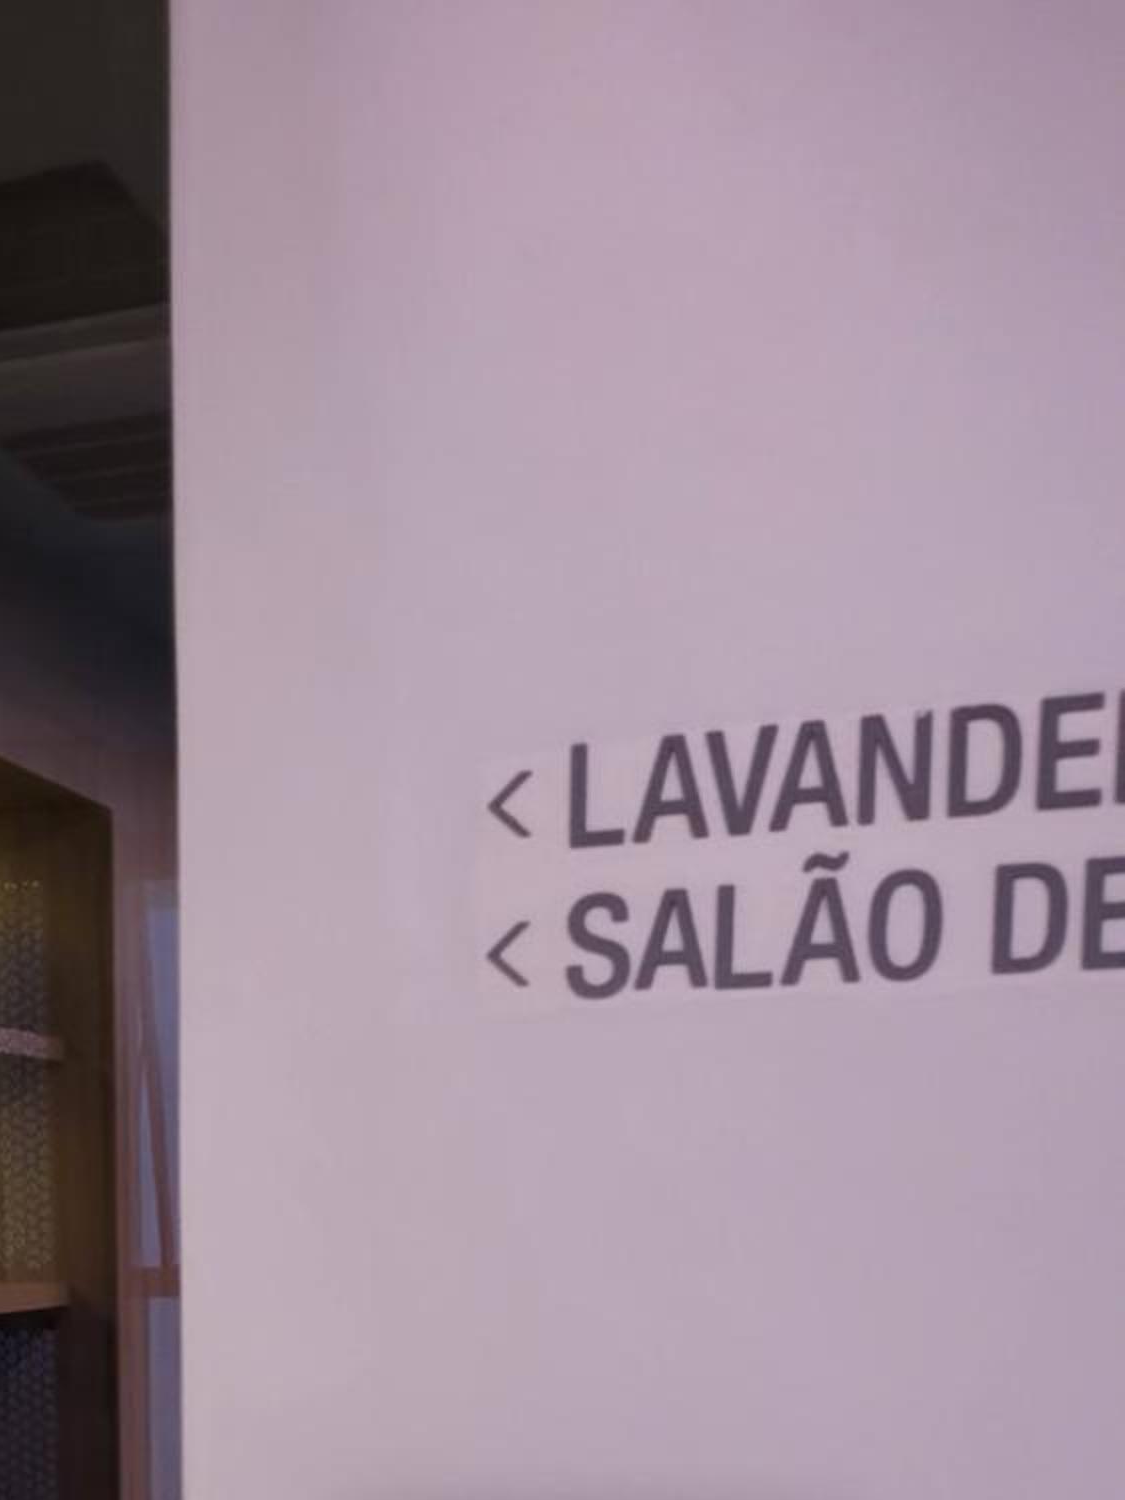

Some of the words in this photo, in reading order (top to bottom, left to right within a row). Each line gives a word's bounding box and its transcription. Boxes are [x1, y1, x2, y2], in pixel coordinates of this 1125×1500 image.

[569, 686, 1125, 849] LAVANDE
[565, 852, 943, 1000] SALÃO
[991, 856, 1125, 975] DE
